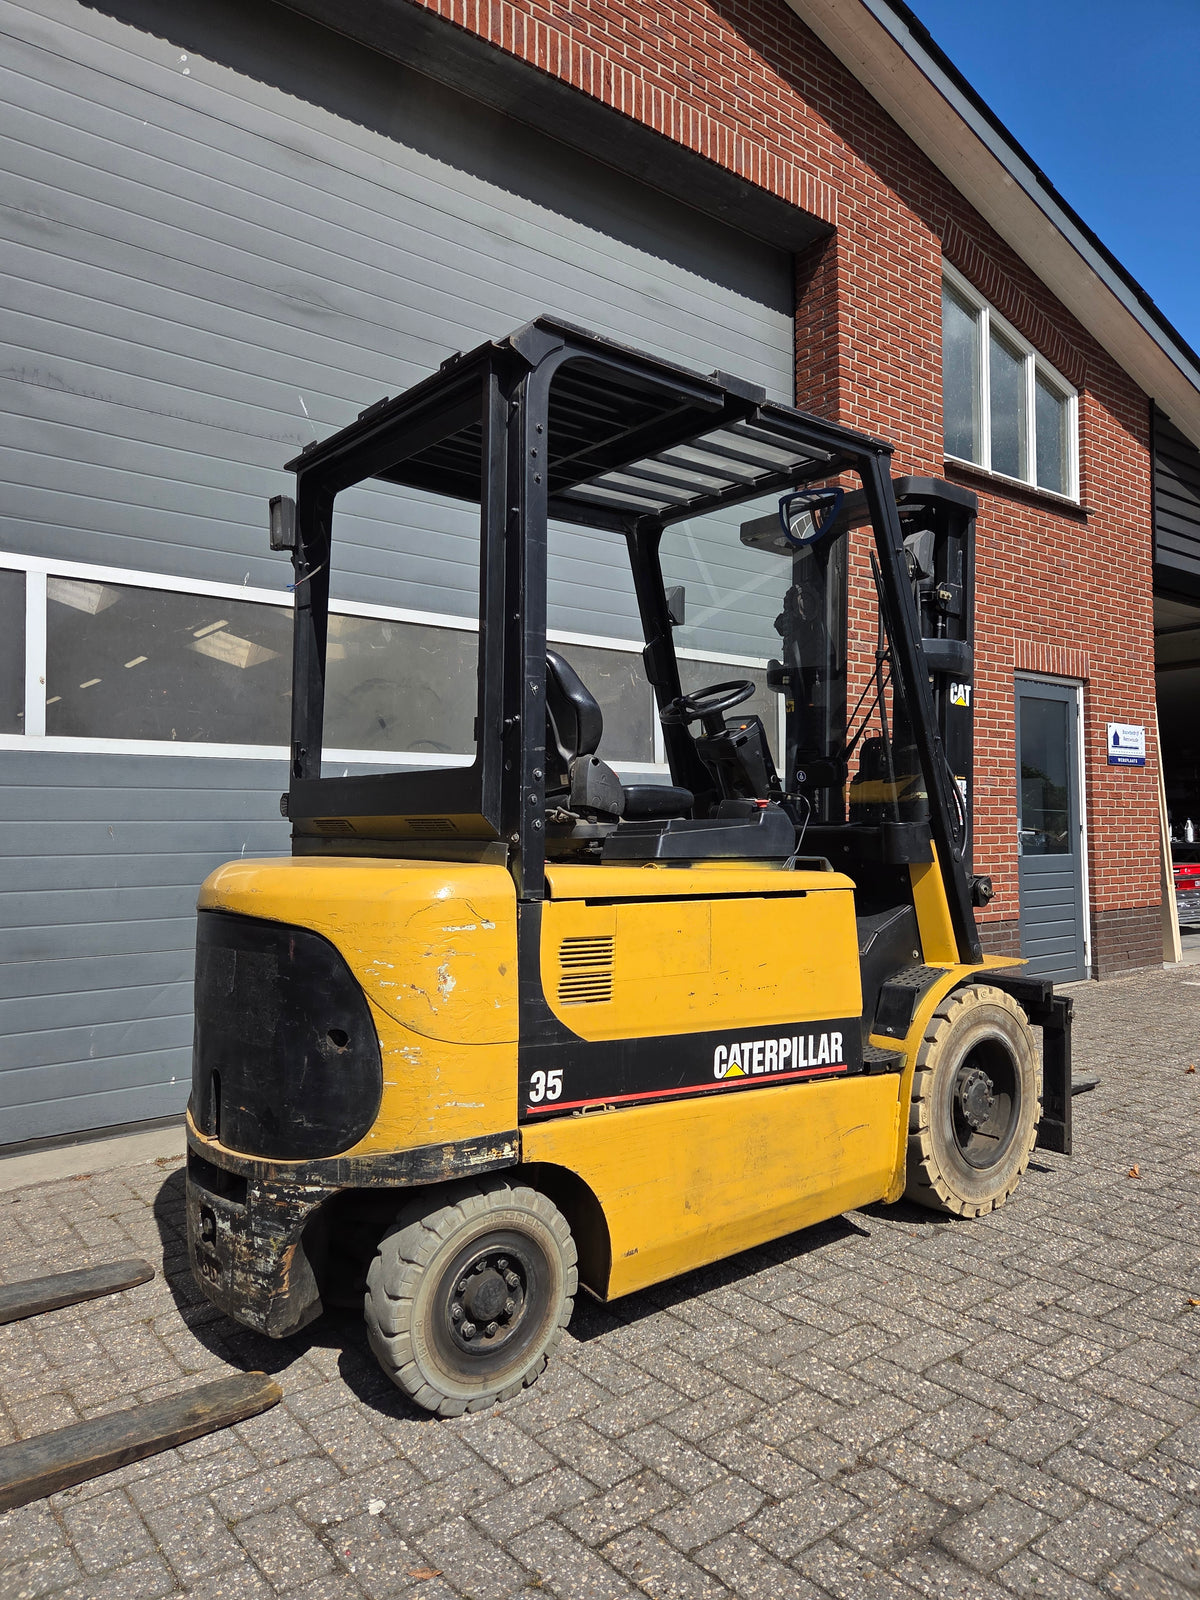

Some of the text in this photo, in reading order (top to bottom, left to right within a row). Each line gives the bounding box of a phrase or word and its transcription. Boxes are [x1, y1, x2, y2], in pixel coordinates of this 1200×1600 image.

[950, 682, 972, 707] CAT
[713, 1032, 844, 1080] CATERPILLAR
[529, 1069, 564, 1102] 35
